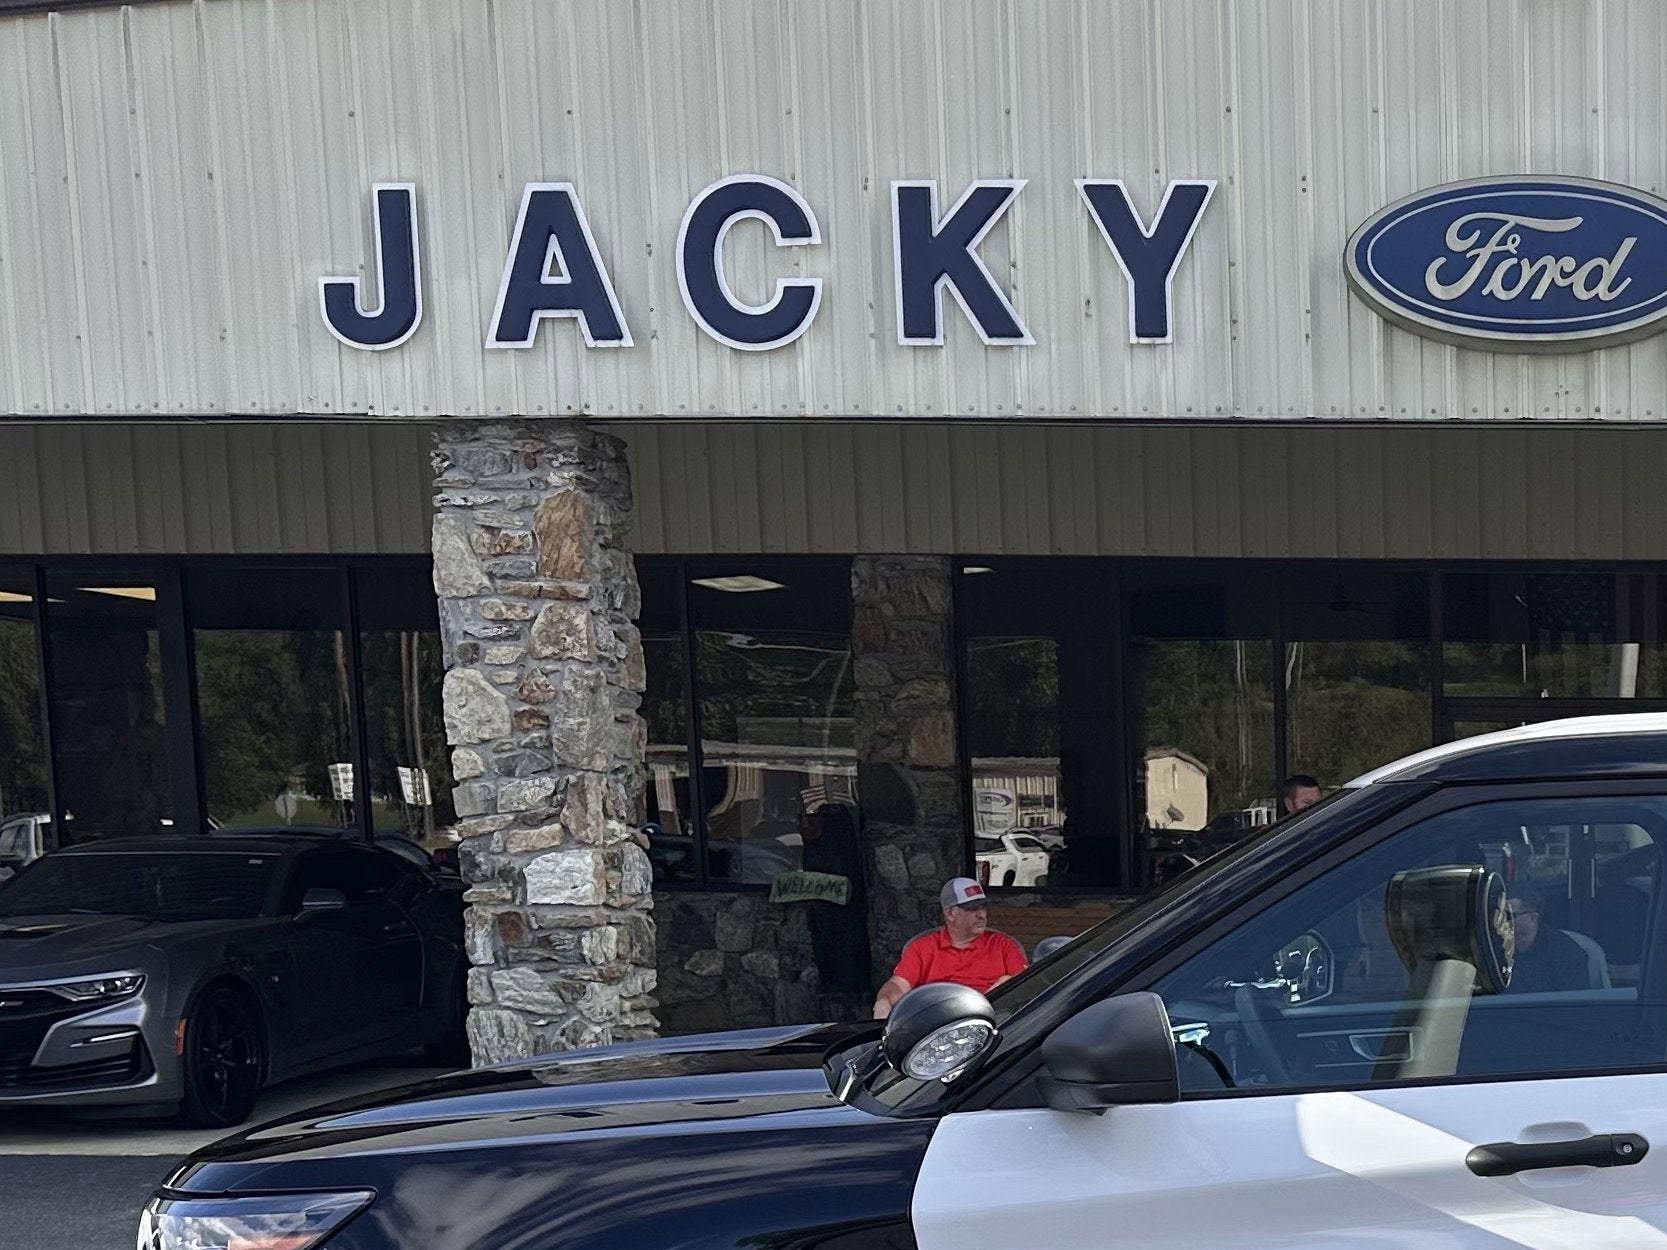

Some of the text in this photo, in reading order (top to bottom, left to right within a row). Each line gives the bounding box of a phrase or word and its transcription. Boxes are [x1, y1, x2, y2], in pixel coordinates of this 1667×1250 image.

[320, 175, 1217, 351] JACKY
[1425, 212, 1638, 301] Ford
[778, 878, 845, 897] WELCOME
